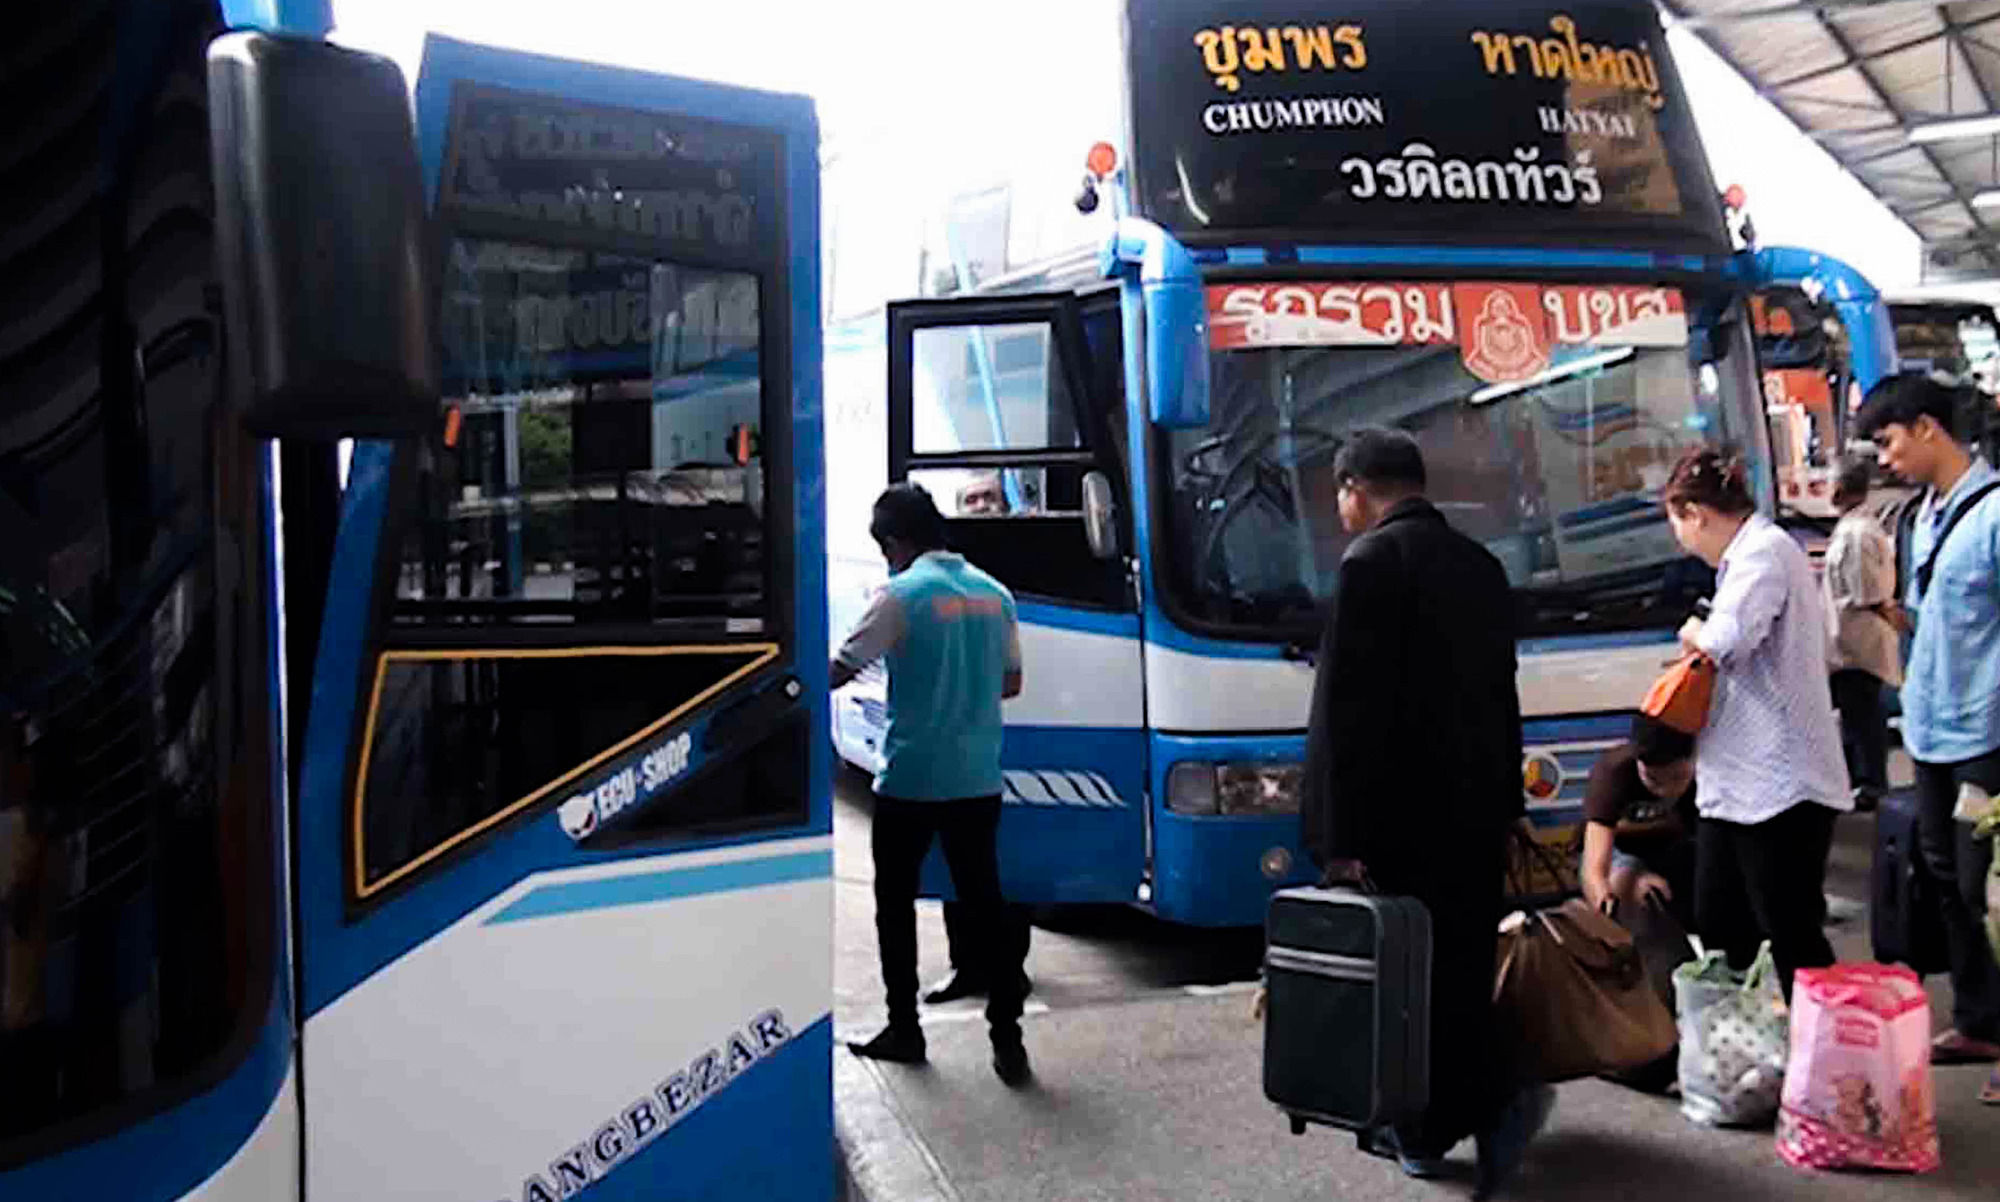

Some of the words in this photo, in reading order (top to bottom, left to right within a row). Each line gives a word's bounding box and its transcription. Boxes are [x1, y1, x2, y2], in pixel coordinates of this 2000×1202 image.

[1194, 25, 1369, 92] ชุมพร
[1472, 14, 1666, 109] หาดใหญ่
[1204, 97, 1385, 133] CHUMPHON
[1538, 106, 1635, 138] HATYAI
[1341, 142, 1601, 204] วรดิลกทัวร์
